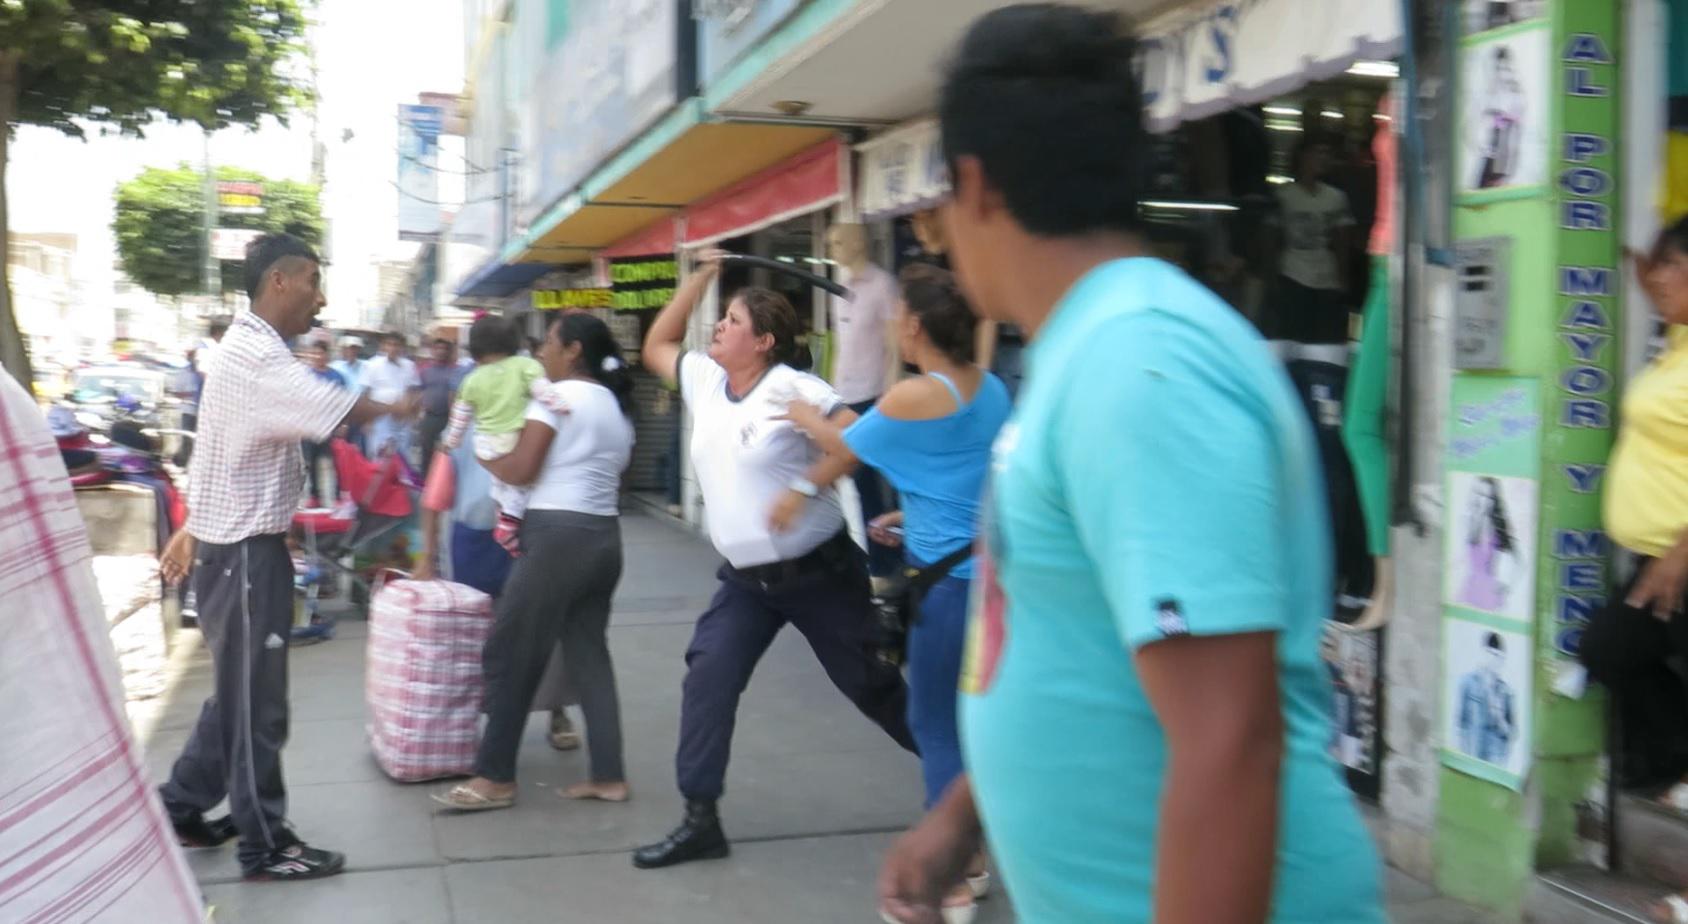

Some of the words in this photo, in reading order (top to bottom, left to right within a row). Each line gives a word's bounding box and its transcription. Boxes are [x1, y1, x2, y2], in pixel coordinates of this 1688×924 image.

[1560, 33, 1615, 97] AL
[1557, 131, 1615, 232] POR
[1557, 265, 1618, 428] MAYOR
[1561, 464, 1607, 494] Y
